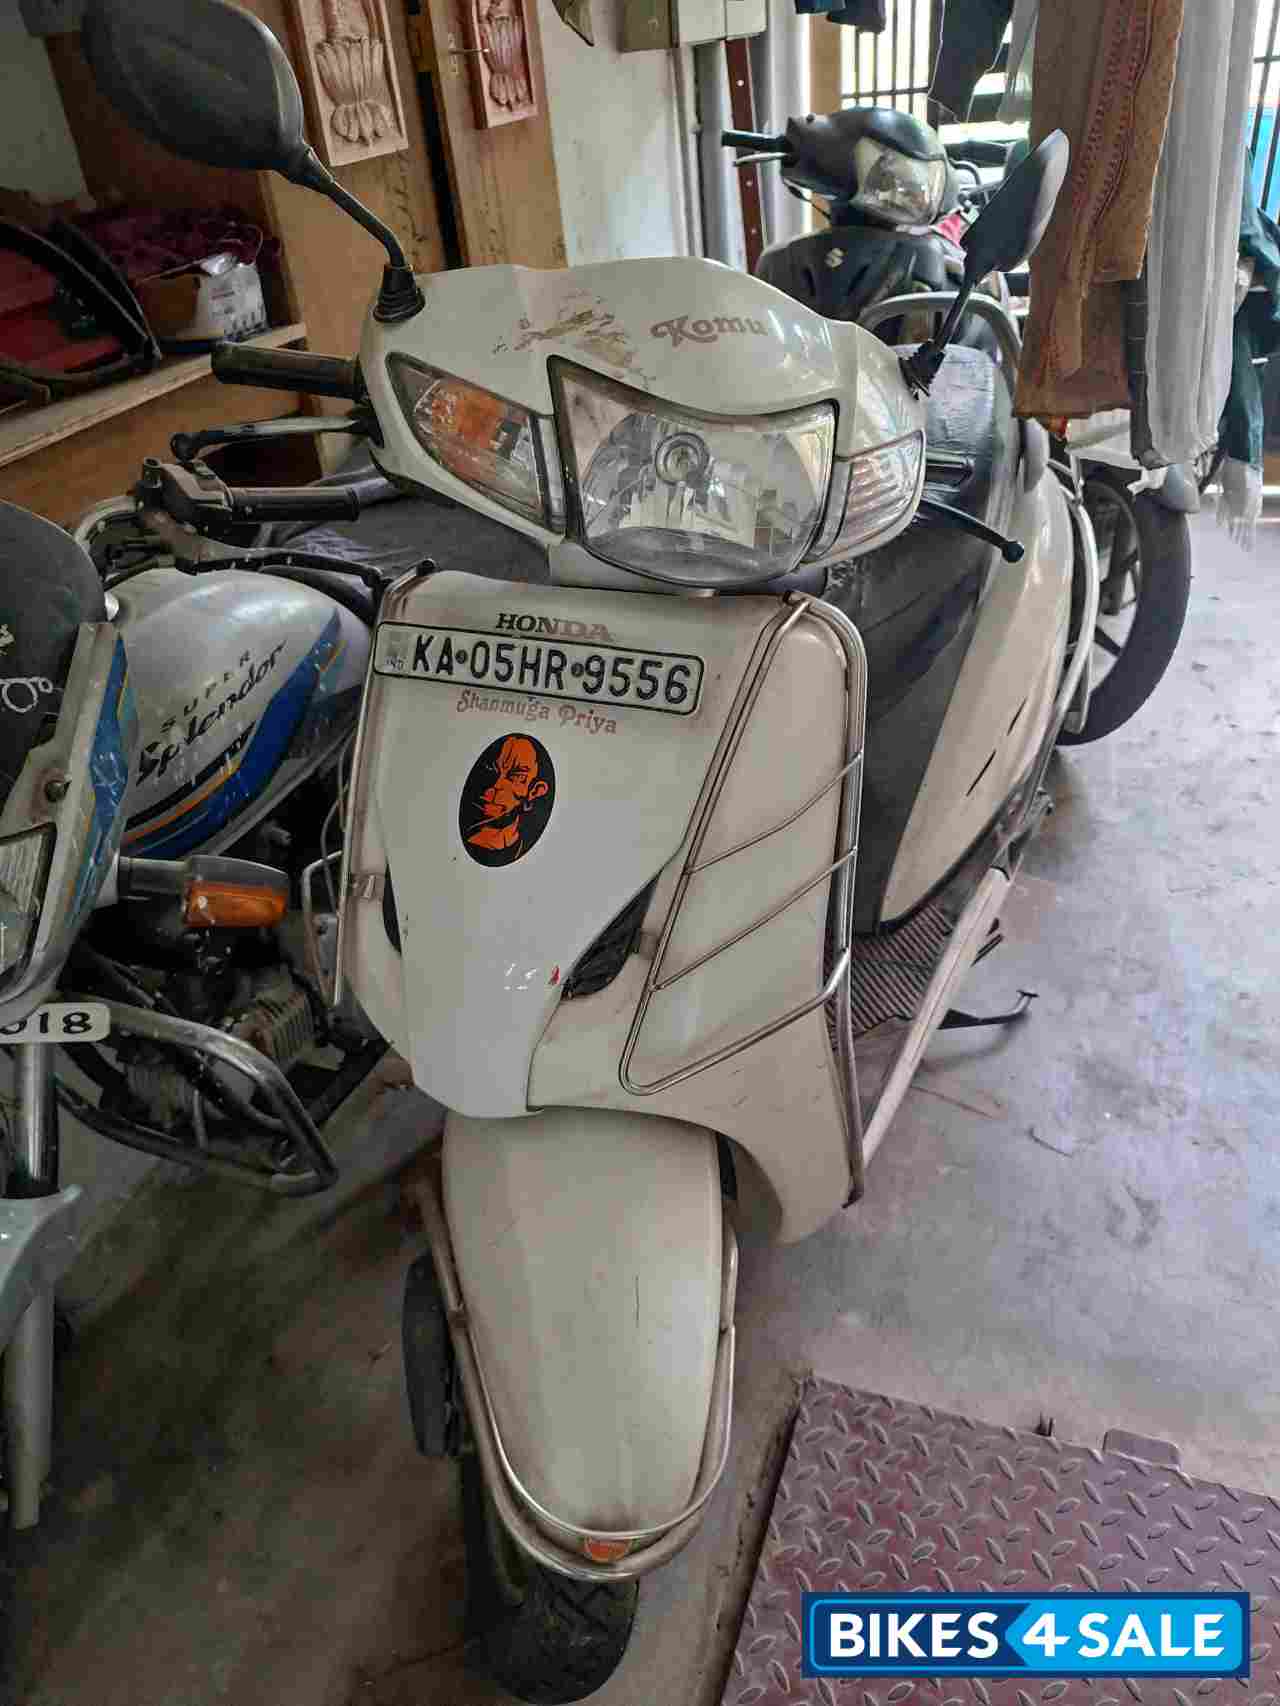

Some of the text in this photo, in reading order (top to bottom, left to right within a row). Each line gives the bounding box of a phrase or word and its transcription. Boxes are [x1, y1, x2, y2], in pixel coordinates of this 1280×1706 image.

[496, 613, 615, 641] HONDA
[136, 639, 288, 787] Splendor
[457, 688, 616, 734] Shanmuga Priya
